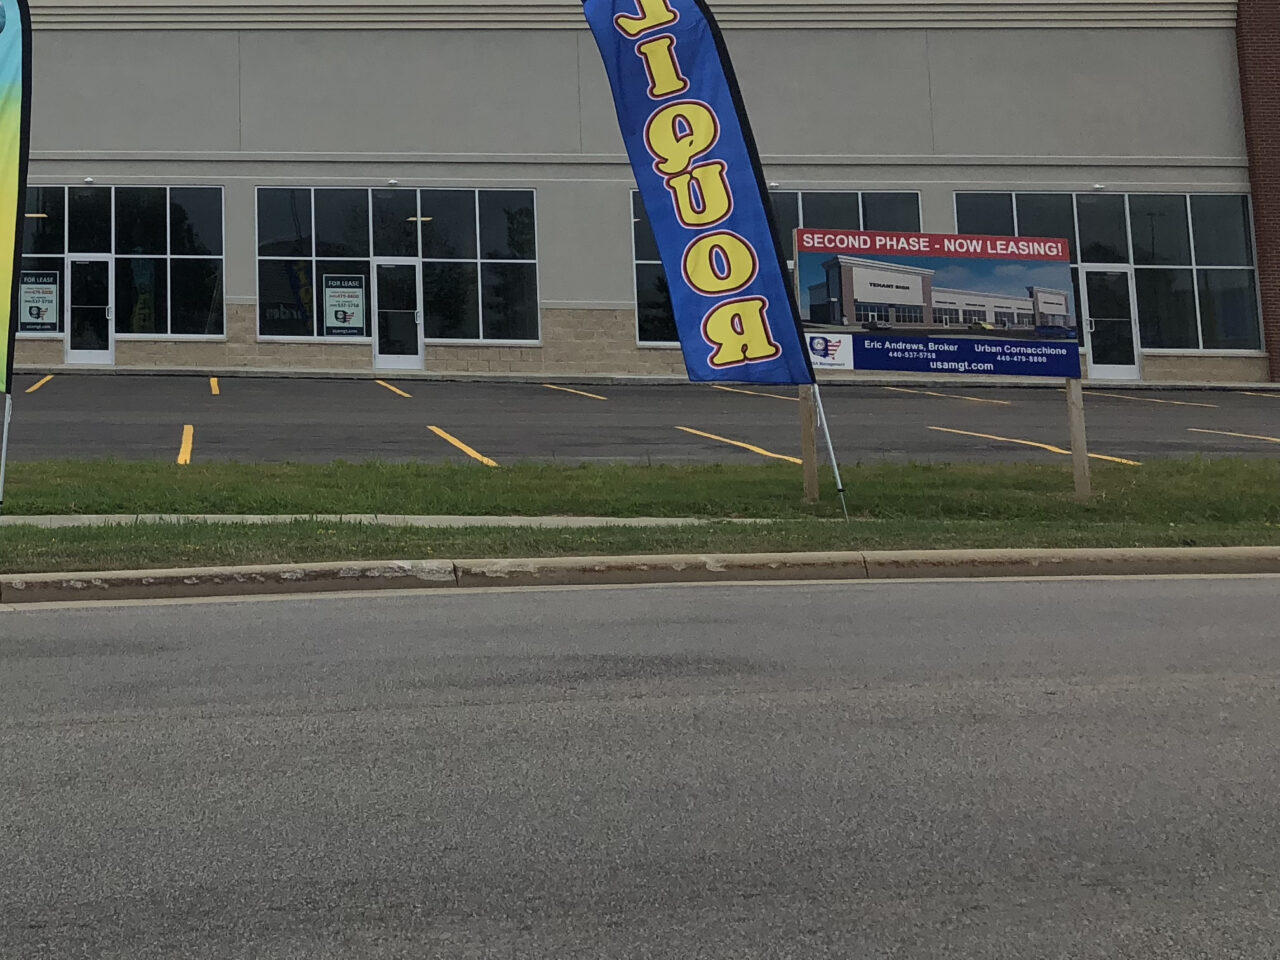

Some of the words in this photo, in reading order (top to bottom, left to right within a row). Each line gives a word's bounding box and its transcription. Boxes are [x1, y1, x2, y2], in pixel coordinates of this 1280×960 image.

[802, 233, 871, 249] SECOND
[875, 236, 930, 251] PHASE
[943, 239, 982, 254] NOW
[986, 241, 1063, 256] LEASING!
[864, 340, 882, 349] Eric
[884, 341, 926, 351] Andrews,
[928, 342, 959, 352] Broker
[974, 343, 1002, 353] Urban
[1003, 345, 1067, 355] Cornacchione
[929, 360, 994, 372] usamgt.com
